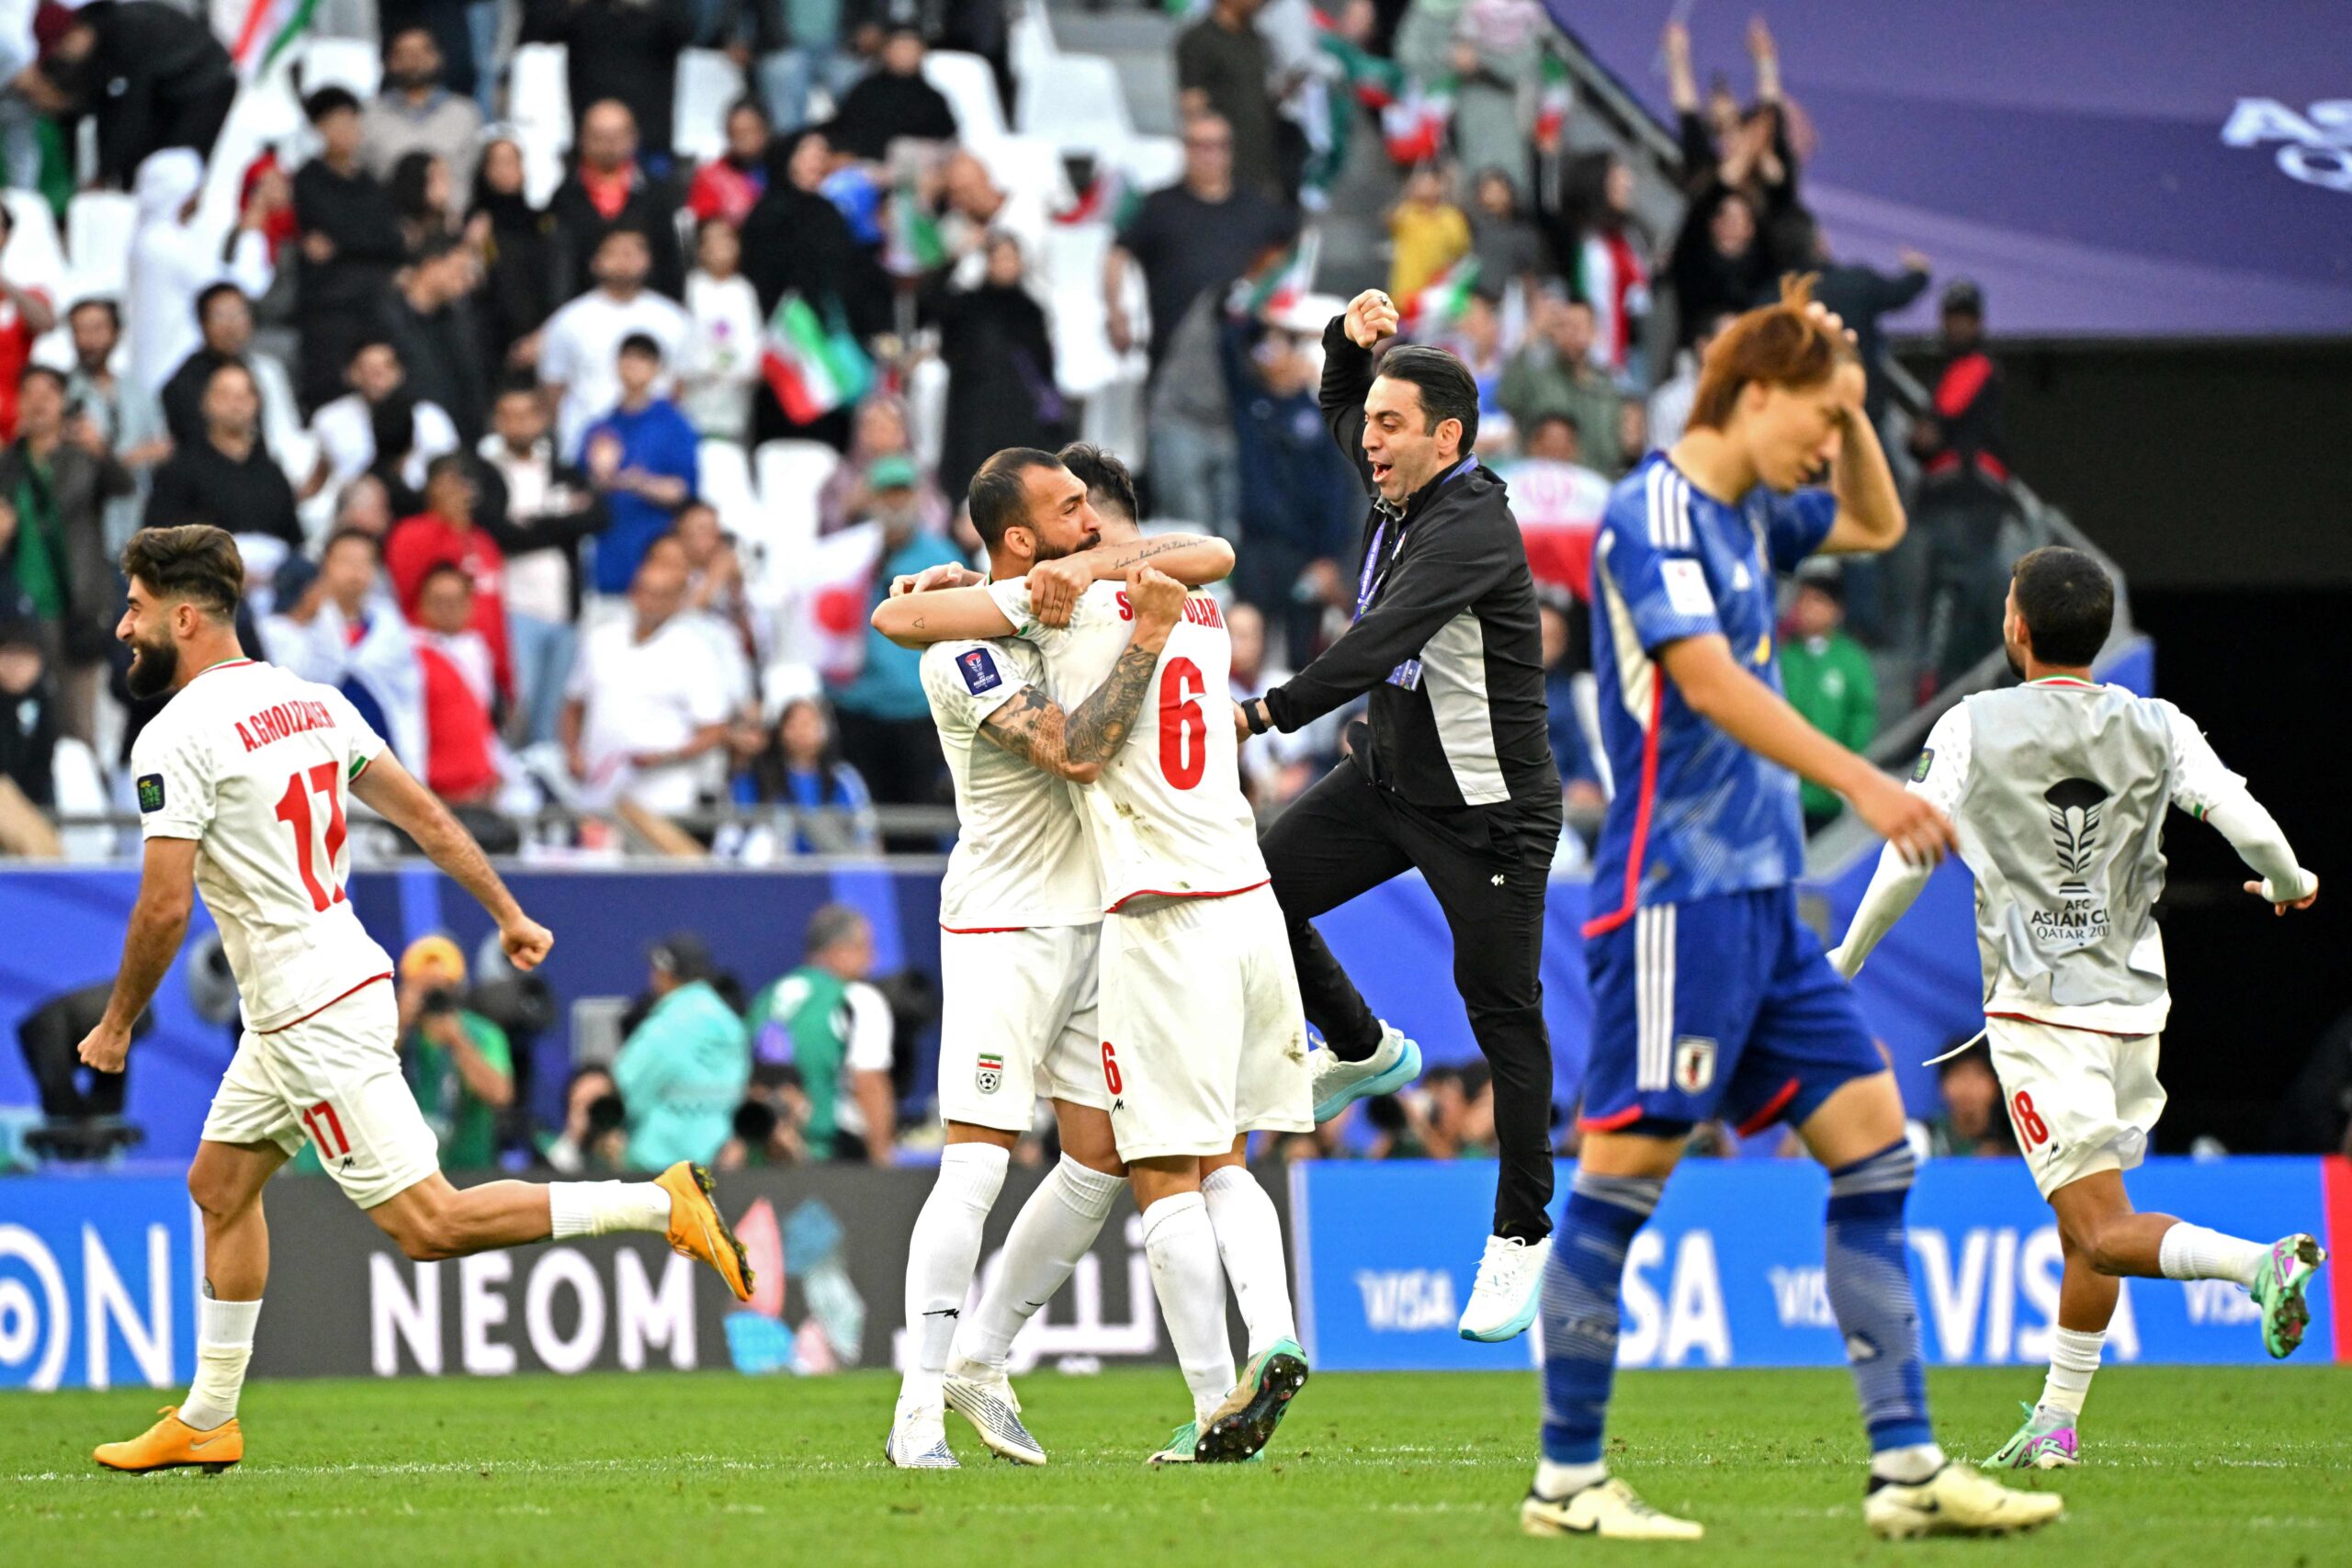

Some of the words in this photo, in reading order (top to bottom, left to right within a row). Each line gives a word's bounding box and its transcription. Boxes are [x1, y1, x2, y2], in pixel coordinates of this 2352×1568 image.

[1159, 656, 1207, 791] 6
[274, 760, 348, 913] 17
[2030, 910, 2087, 928] ASIAN
[2036, 926, 2085, 940] QATAR
[2064, 899, 2090, 911] AFC
[1102, 1042, 1123, 1095] 6
[303, 1100, 351, 1159] 17
[2009, 1090, 2049, 1153] 18
[369, 1247, 698, 1377] NEOM
[1352, 1268, 1457, 1330] VISA
